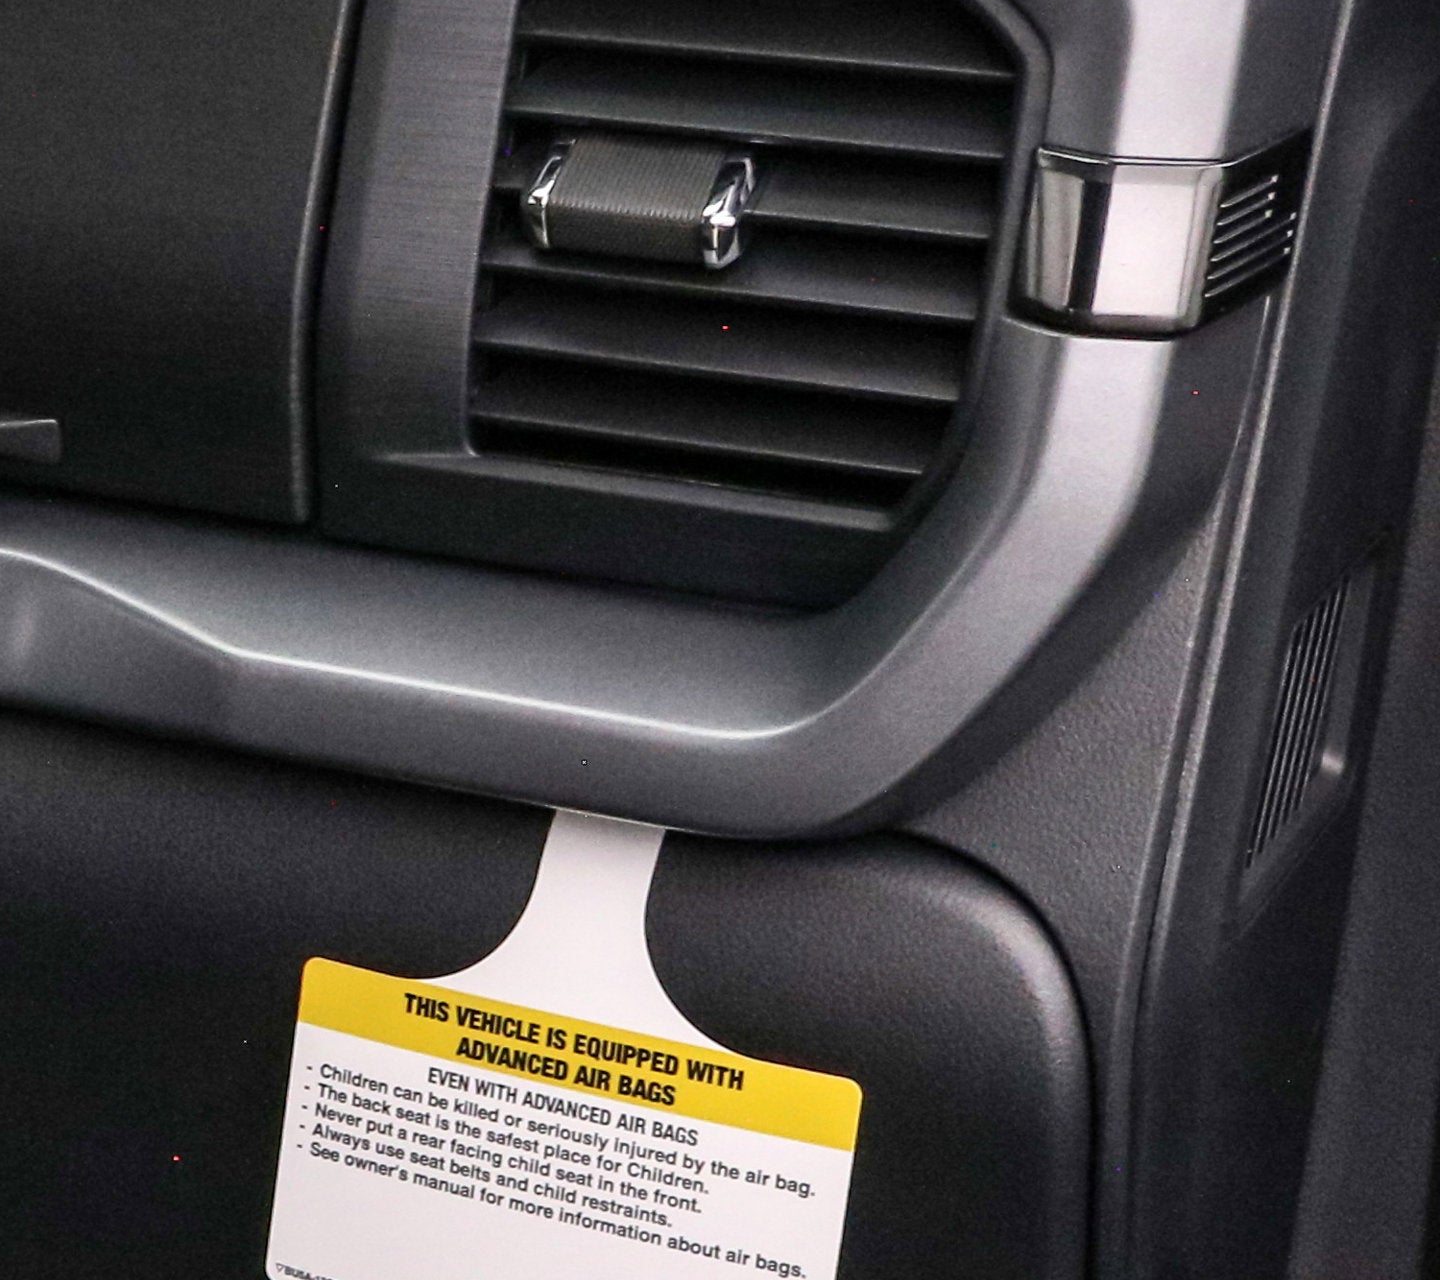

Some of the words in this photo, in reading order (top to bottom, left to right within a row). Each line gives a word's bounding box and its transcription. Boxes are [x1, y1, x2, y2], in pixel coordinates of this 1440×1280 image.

[403, 992, 451, 1023] THIS
[455, 1004, 542, 1045] VEHICLE
[544, 1026, 569, 1051] IS
[572, 1032, 680, 1077] EQUIPPED
[685, 1058, 745, 1092] WITH
[455, 1036, 570, 1082] ADVANCED
[572, 1064, 612, 1093] AIR
[616, 1073, 677, 1107] BAGS
[314, 1101, 364, 1129] Never
[365, 1119, 395, 1138] put
[396, 1127, 408, 1141] a
[411, 1131, 447, 1151] rear
[449, 1138, 504, 1169] facing
[507, 1155, 552, 1178] child
[554, 1168, 594, 1189] seat
[596, 1174, 615, 1194] in
[619, 1181, 649, 1201] the
[652, 1188, 702, 1214] front.
[317, 1082, 349, 1104] The
[350, 1091, 392, 1117] back
[394, 1106, 432, 1127] seat
[434, 1113, 451, 1132] is
[454, 1119, 483, 1140] the
[485, 1130, 541, 1155] safest
[542, 1143, 592, 1167] place
[596, 1150, 623, 1174] for
[626, 1161, 709, 1195] Children.
[319, 1063, 389, 1096] Children
[392, 1085, 424, 1105] can
[427, 1090, 450, 1111] be
[452, 1097, 500, 1124] killed
[503, 1114, 524, 1129] or
[526, 1119, 610, 1153] seriously
[613, 1136, 679, 1166] injured
[681, 1152, 706, 1176] by
[710, 1160, 741, 1180] the
[744, 1169, 771, 1187] air
[774, 1173, 816, 1199] bag.
[427, 1066, 471, 1093] EVEN
[474, 1078, 519, 1105] WITH
[521, 1090, 613, 1127] ADVANCED
[615, 1112, 647, 1136] AIR
[650, 1120, 699, 1147] BAGS
[309, 1141, 341, 1163] See
[343, 1148, 409, 1182] owner's
[412, 1172, 476, 1200] manual
[479, 1186, 506, 1207] for
[508, 1197, 555, 1220] more
[558, 1206, 663, 1246] information
[666, 1235, 722, 1260] about
[724, 1248, 751, 1266] air
[754, 1253, 807, 1279] bags.
[311, 1122, 371, 1152] Always
[374, 1141, 406, 1161] use
[408, 1151, 446, 1172] seat
[449, 1159, 491, 1183] belts
[495, 1175, 530, 1193] and
[533, 1182, 577, 1205] child
[581, 1194, 673, 1229] restraints.
